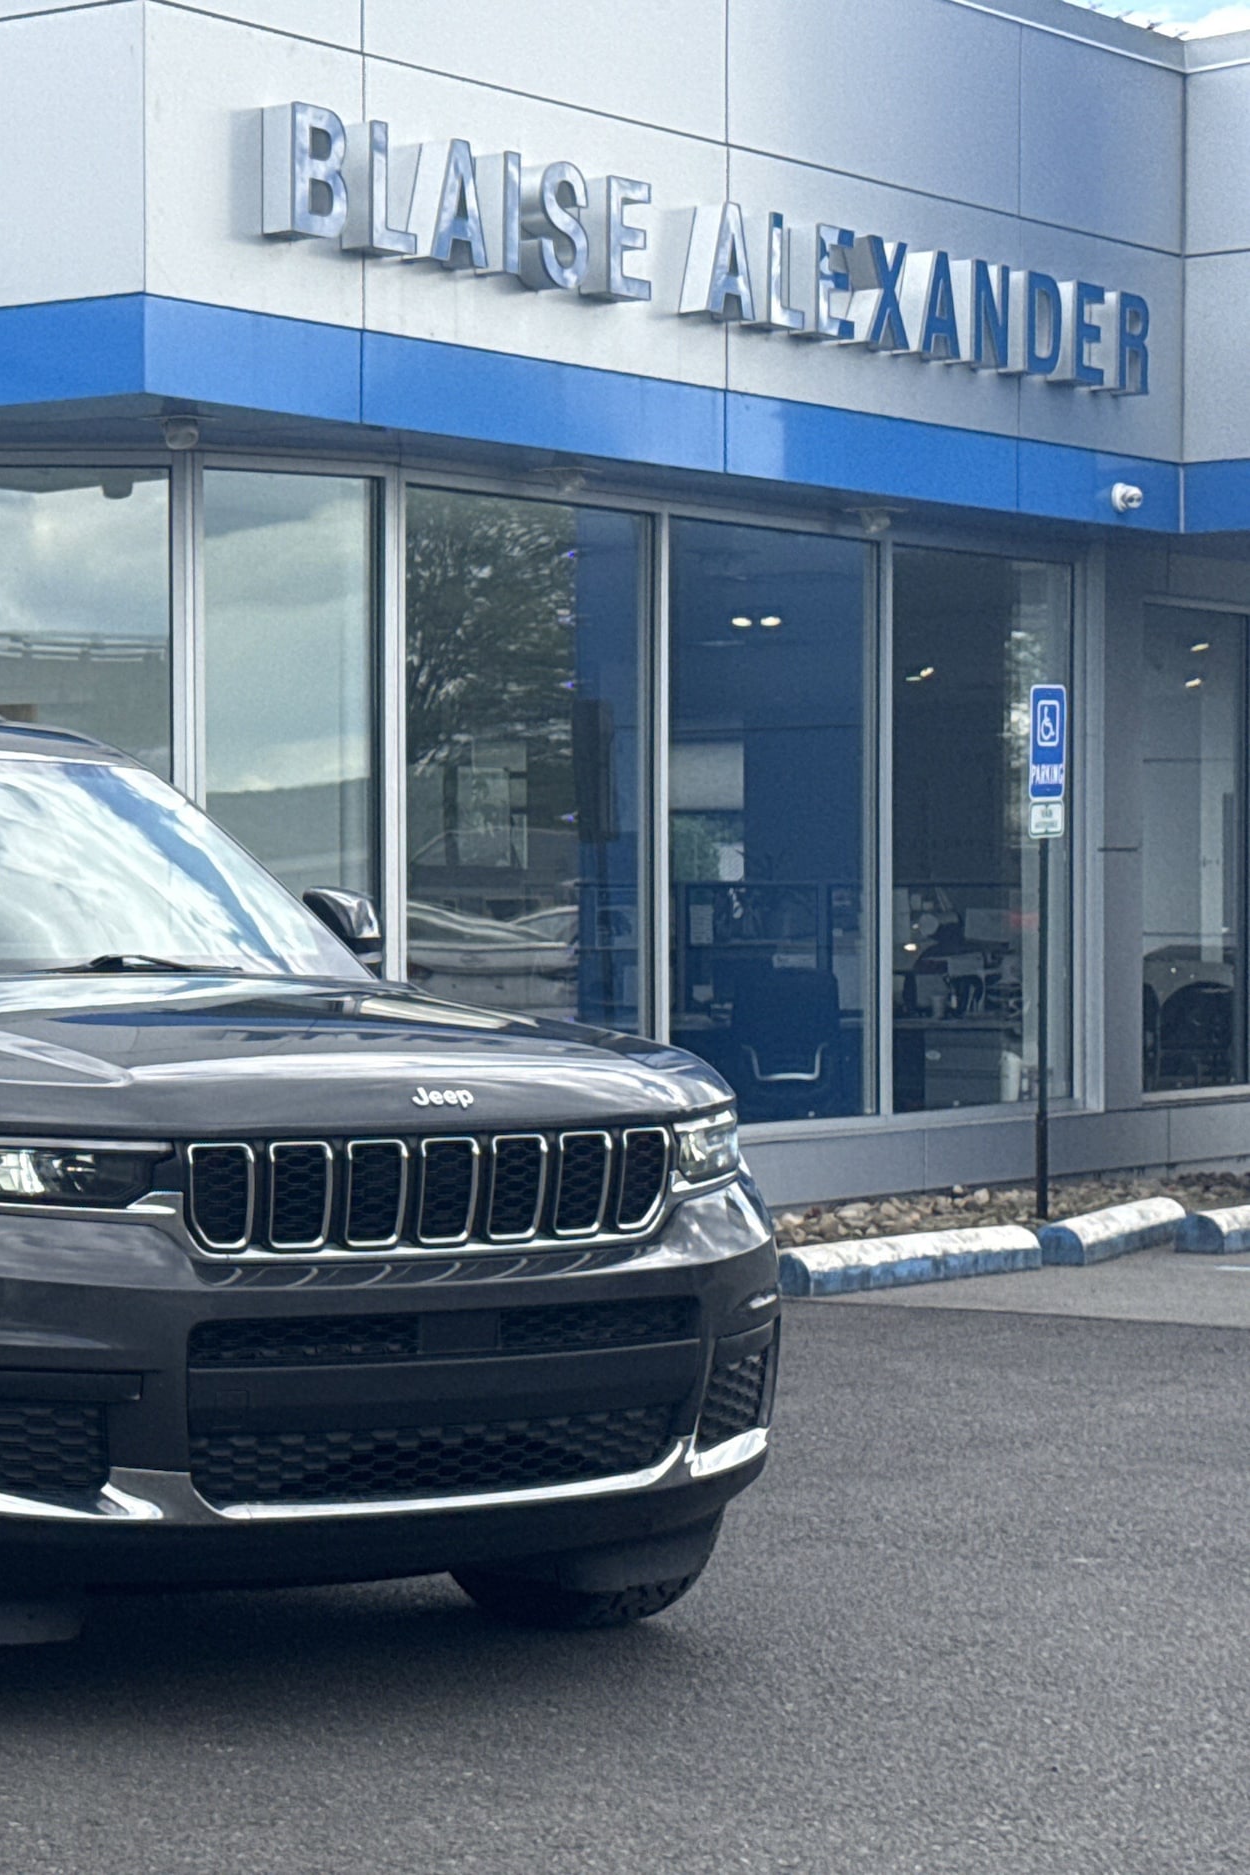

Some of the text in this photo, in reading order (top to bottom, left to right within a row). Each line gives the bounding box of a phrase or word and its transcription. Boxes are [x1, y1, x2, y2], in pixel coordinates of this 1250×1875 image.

[288, 100, 1151, 396] BLAISE ALEXANDER
[1030, 764, 1064, 785] PARKING
[411, 1086, 474, 1109] Jeep
